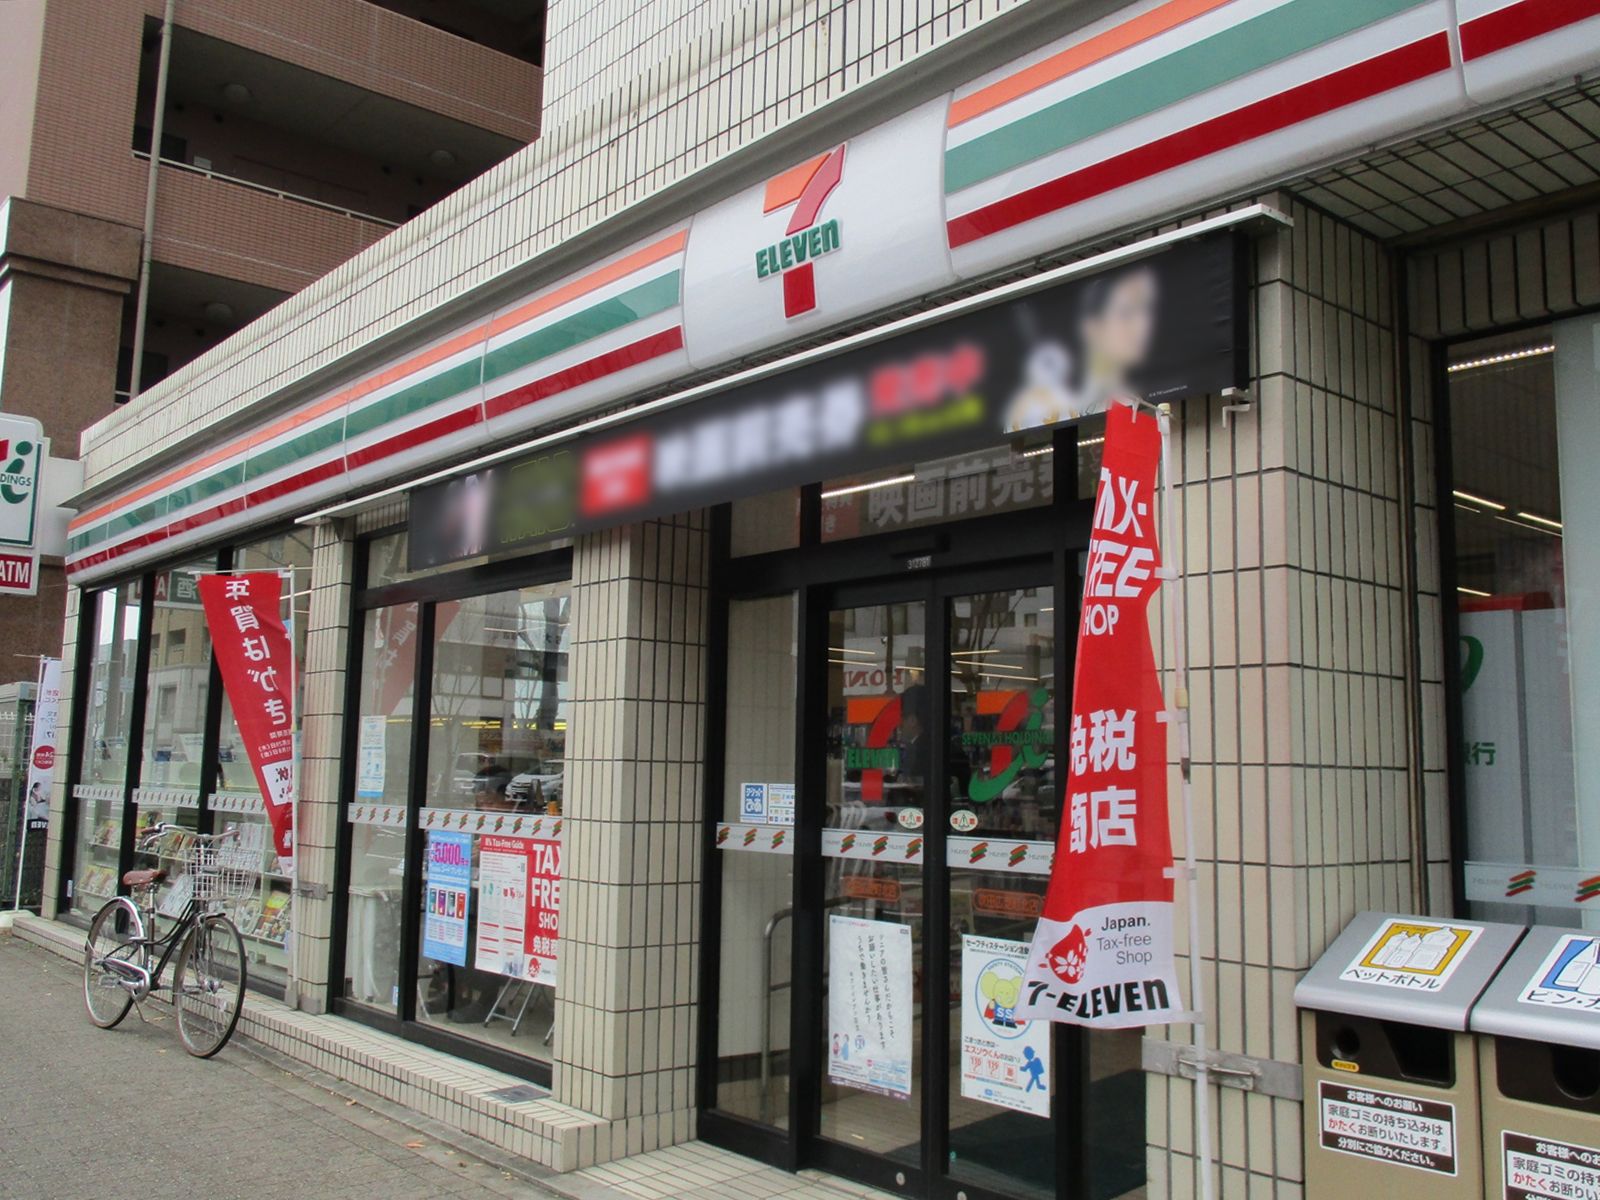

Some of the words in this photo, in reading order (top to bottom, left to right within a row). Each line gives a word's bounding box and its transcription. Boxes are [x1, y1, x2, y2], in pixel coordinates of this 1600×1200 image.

[1101, 916, 1151, 932] Japan.
[1096, 934, 1152, 949] Tax-free
[1116, 950, 1153, 966] Shop
[1346, 968, 1440, 990] ペットボトル
[1347, 1090, 1423, 1113] お客様へのお願い
[1328, 1104, 1444, 1137] 家庭ゴミの持ち込みは
[1337, 1137, 1436, 1167] 分別にご協力ください。
